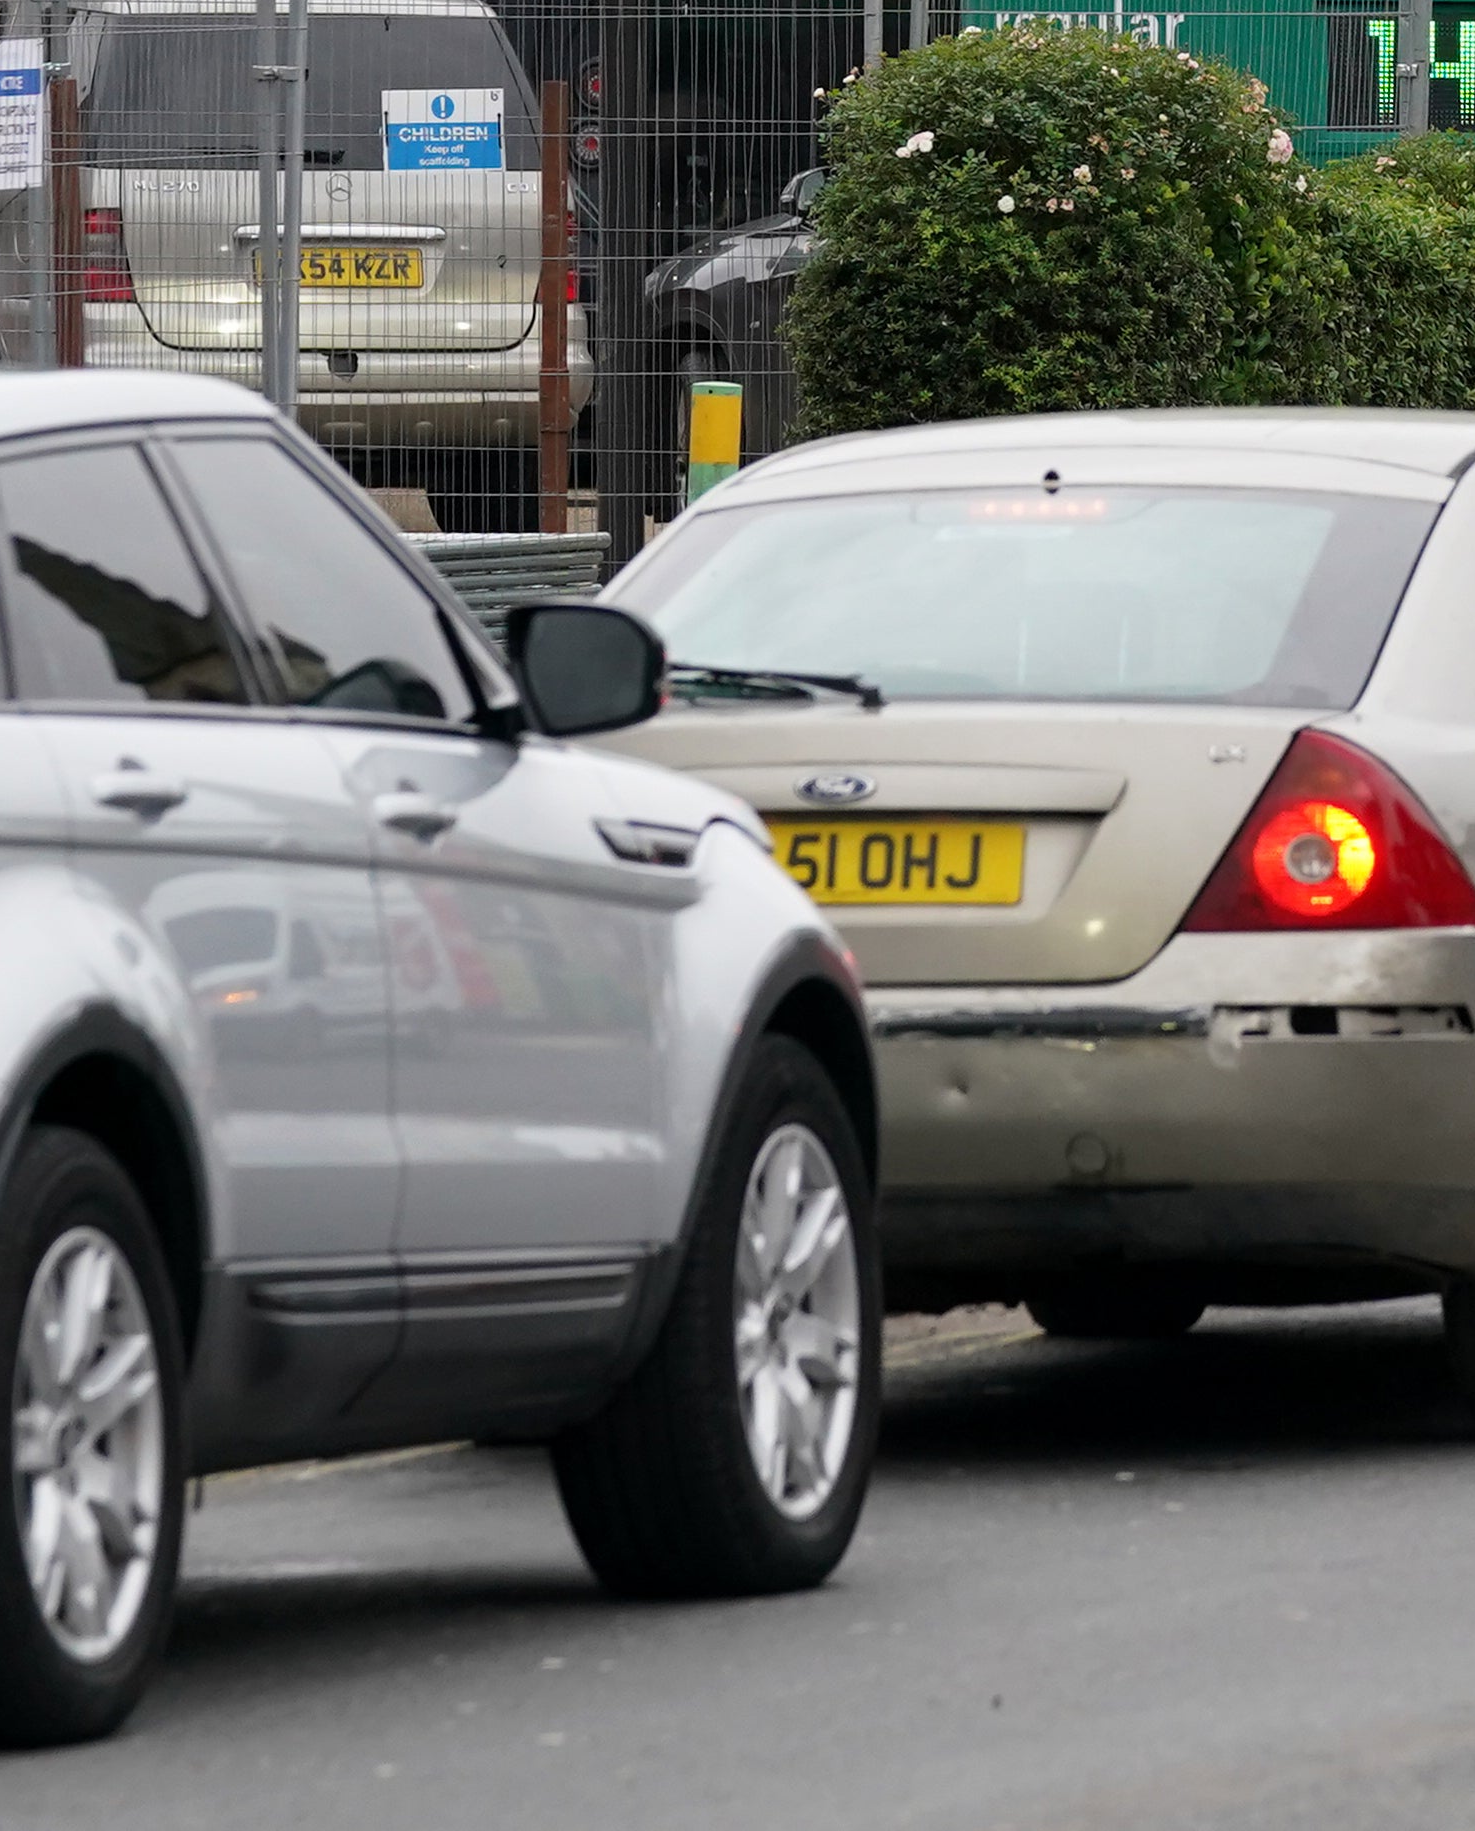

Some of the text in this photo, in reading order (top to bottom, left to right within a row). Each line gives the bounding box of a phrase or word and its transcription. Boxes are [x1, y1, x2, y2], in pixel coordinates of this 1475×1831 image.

[398, 125, 489, 143] CHILDREN
[424, 143, 465, 155] Keep off
[418, 156, 471, 167] scaffolding
[353, 253, 412, 280] KZR
[860, 832, 982, 890] OHJ
